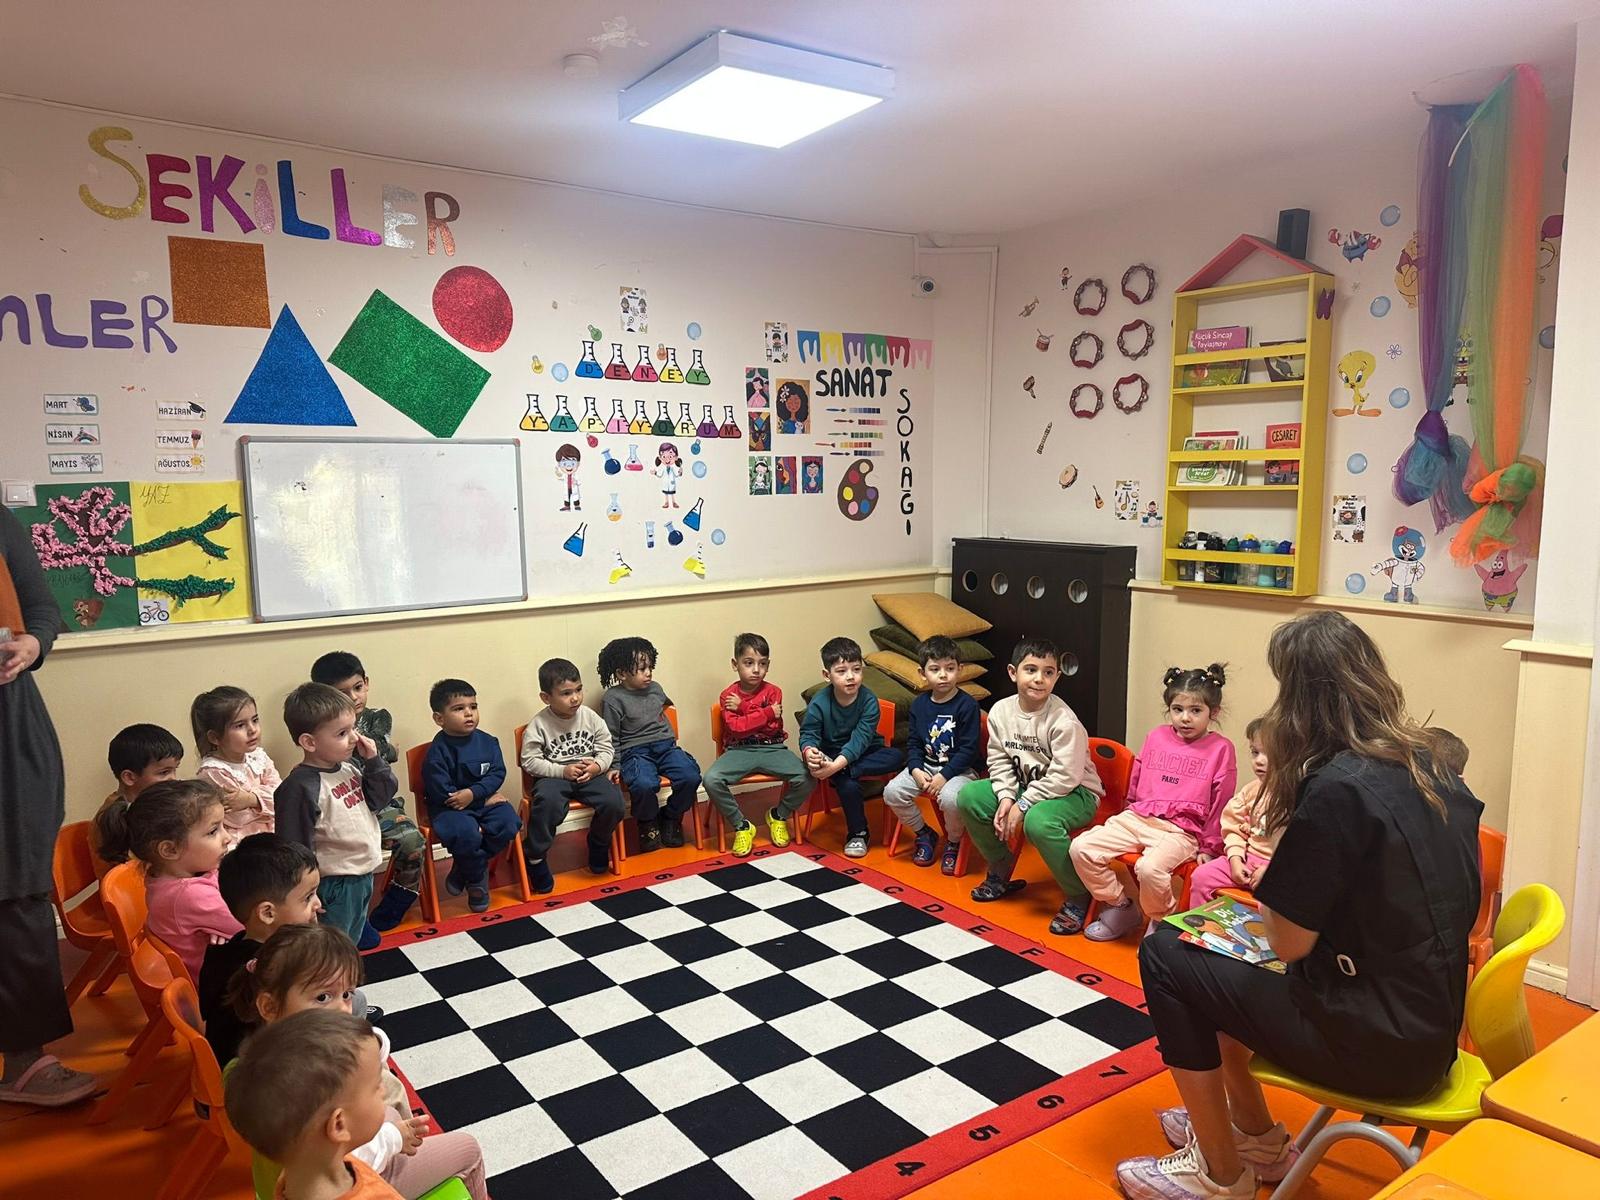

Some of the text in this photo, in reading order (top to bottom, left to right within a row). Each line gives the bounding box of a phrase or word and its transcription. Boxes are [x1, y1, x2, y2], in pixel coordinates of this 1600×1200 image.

[585, 363, 702, 380] DENEY
[815, 366, 893, 398] SANAT
[46, 400, 69, 410] MART
[158, 406, 192, 416] HAZİRAN
[529, 415, 734, 436] YAPIYORUM
[48, 429, 73, 439] NİSAN
[158, 435, 190, 445] TEMMUZ
[1271, 429, 1298, 443] CESARET
[51, 460, 78, 469] MAYIS
[157, 457, 191, 469] AĞUSTOS
[1161, 774, 1180, 785] PARIS
[414, 927, 438, 938] 2
[481, 914, 503, 922] 3
[544, 900, 563, 908] 4
[600, 886, 620, 894] 5
[753, 849, 770, 857] 8
[841, 867, 863, 875] B
[883, 886, 904, 894] C
[921, 903, 944, 912] D
[968, 924, 993, 935] E
[1019, 947, 1045, 956] F
[1075, 973, 1102, 985] G
[894, 1065, 1128, 1177] 4 5 6 7
